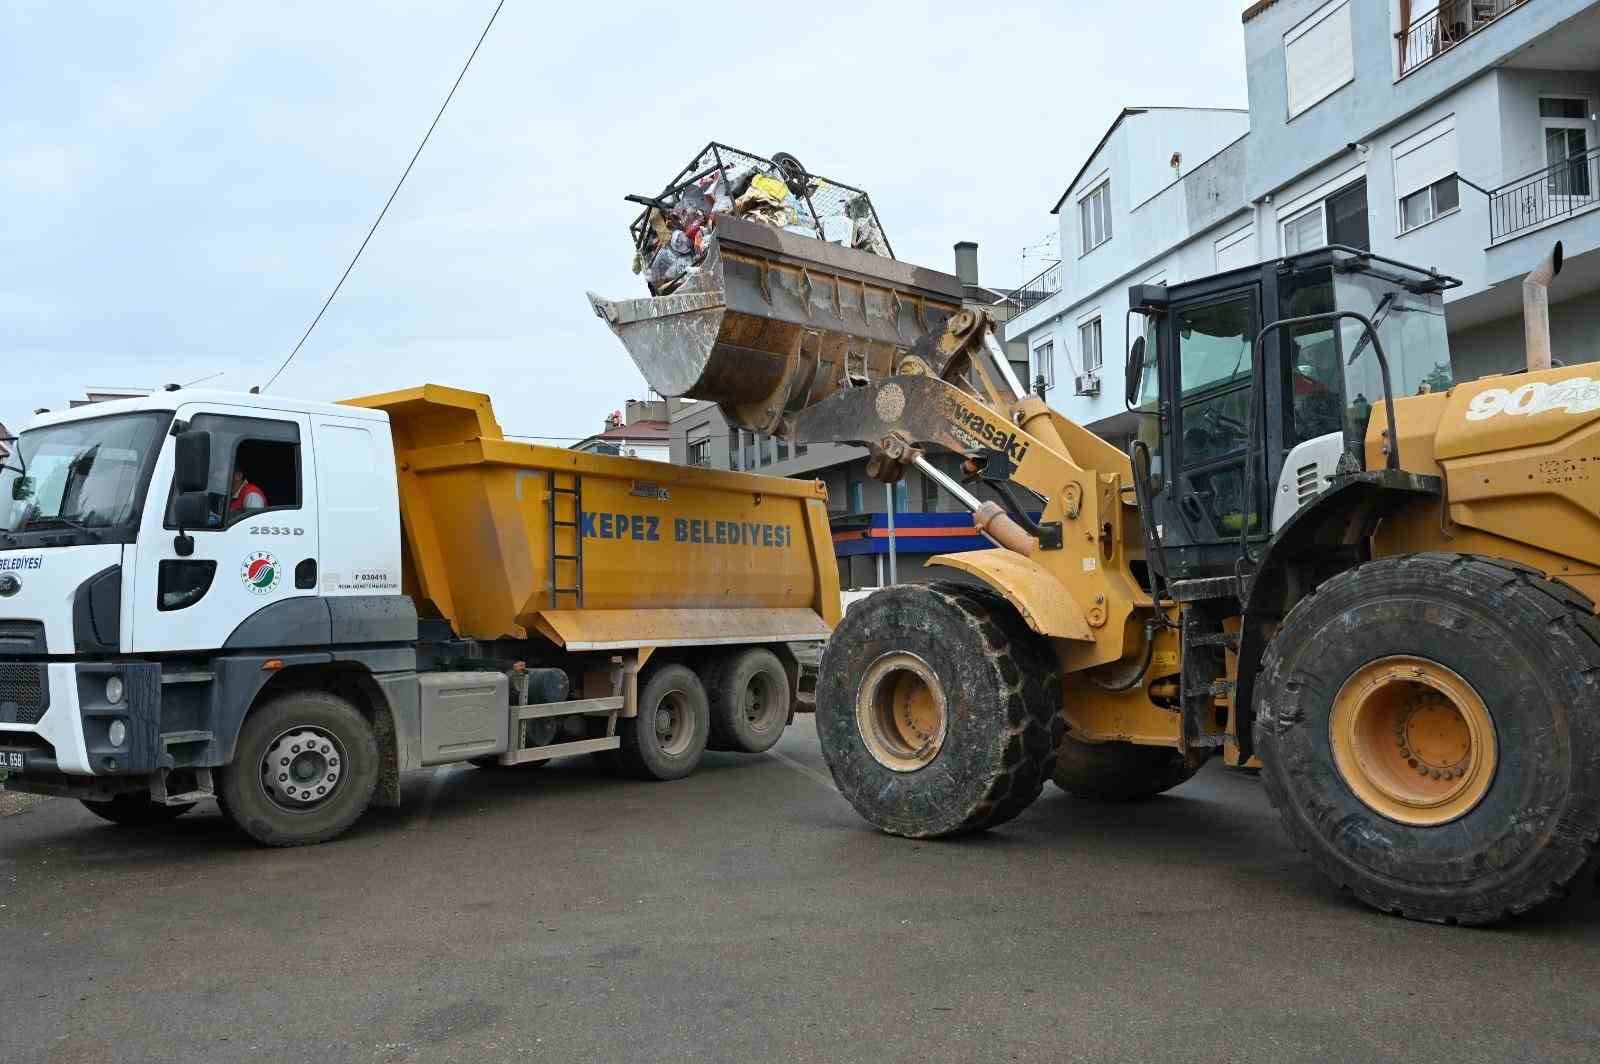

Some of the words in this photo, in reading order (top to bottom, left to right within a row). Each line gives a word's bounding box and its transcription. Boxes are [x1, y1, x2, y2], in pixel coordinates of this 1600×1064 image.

[249, 526, 291, 536] 2533
[293, 528, 305, 536] D
[580, 511, 660, 541] KEPEZ
[674, 519, 791, 549] BELEDİYESİ
[9, 752, 22, 767] 658
